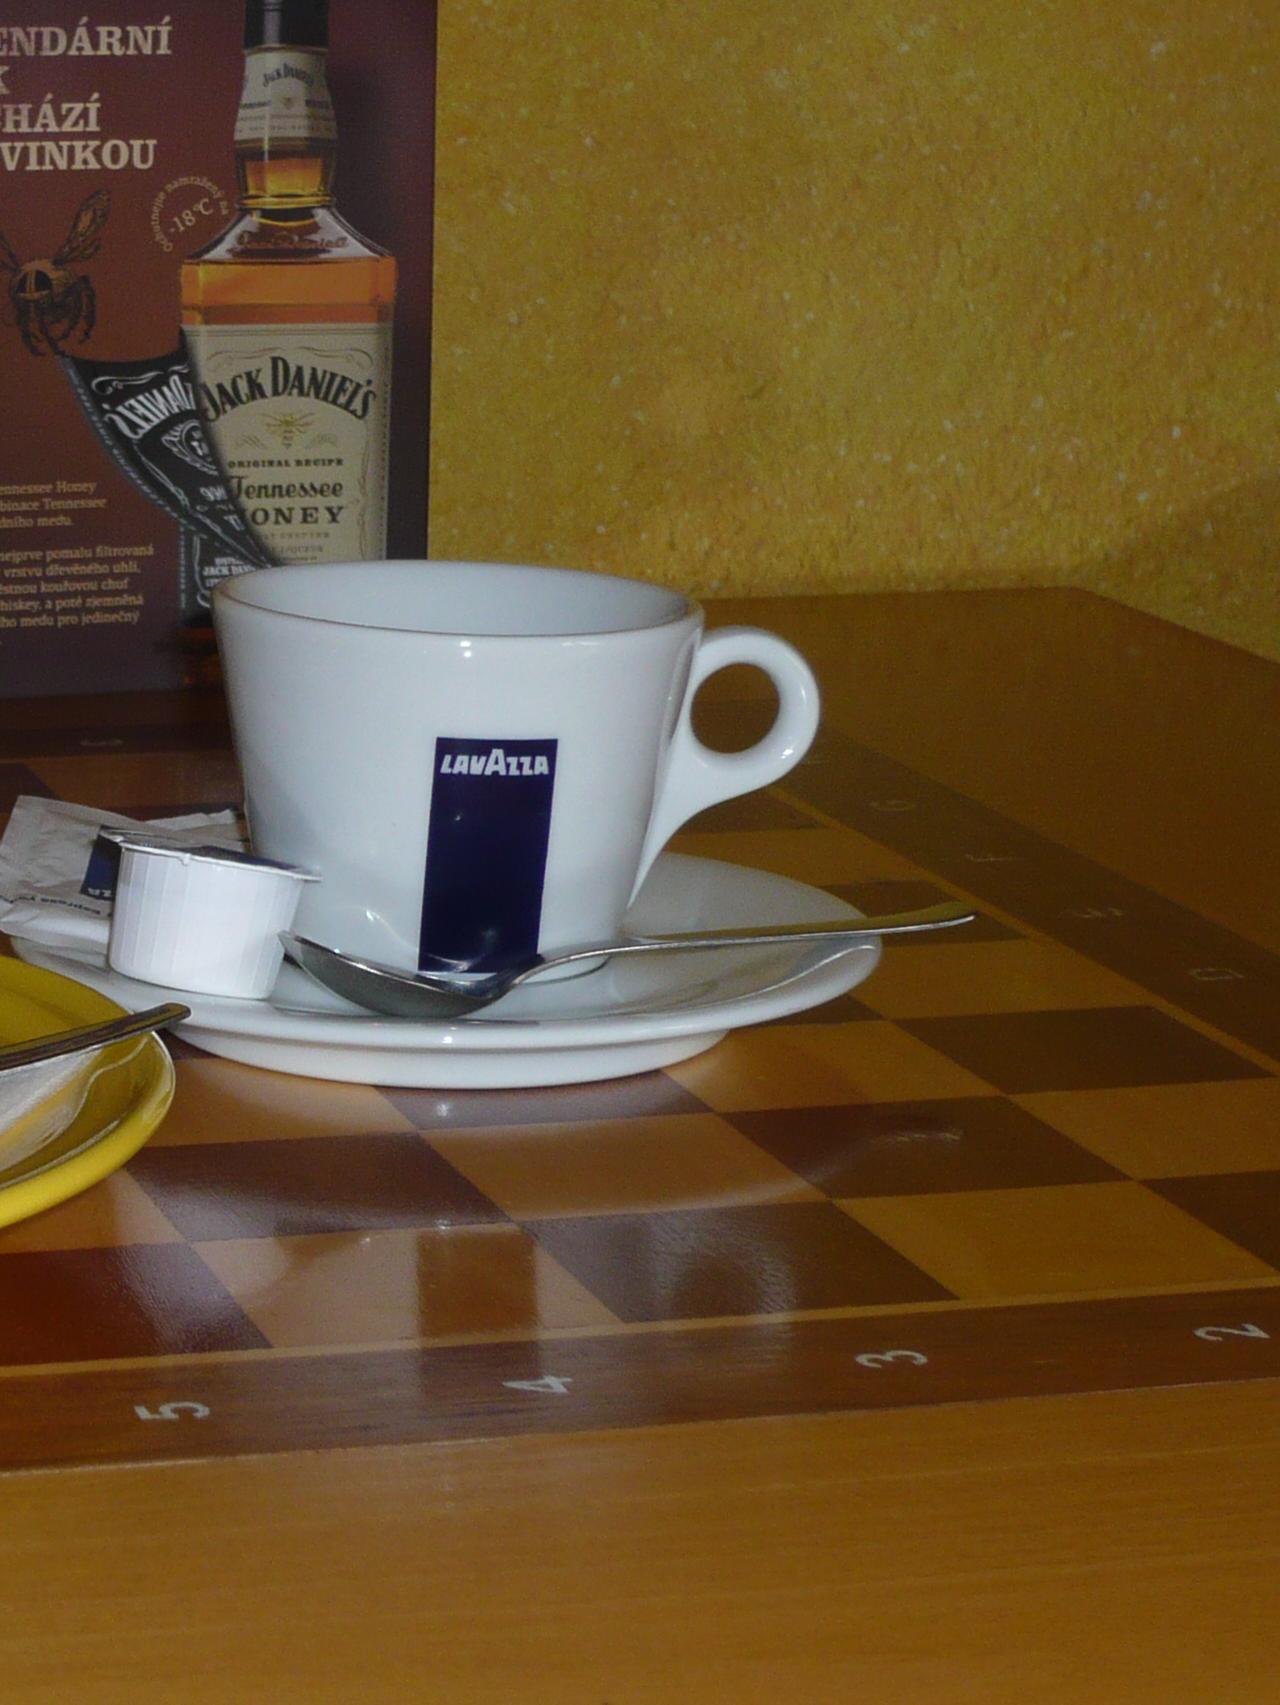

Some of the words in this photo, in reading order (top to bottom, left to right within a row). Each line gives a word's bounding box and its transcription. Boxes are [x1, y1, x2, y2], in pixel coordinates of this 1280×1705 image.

[200, 368, 268, 422] JACK
[269, 356, 377, 420] DANIEL'S
[227, 459, 291, 469] ORIGINAL
[294, 458, 344, 467] RECIPE
[55, 481, 97, 495] Honey
[227, 475, 344, 500] Tennessee
[42, 498, 108, 511] Tennessee
[246, 506, 345, 526] ONEY
[46, 548, 93, 562] pomalu
[20, 614, 55, 627] medu
[57, 614, 79, 628] pro
[439, 748, 550, 776] LAVAZZA
[854, 1349, 928, 1368] 3
[501, 1375, 572, 1394] 4
[133, 1400, 210, 1420] 5
